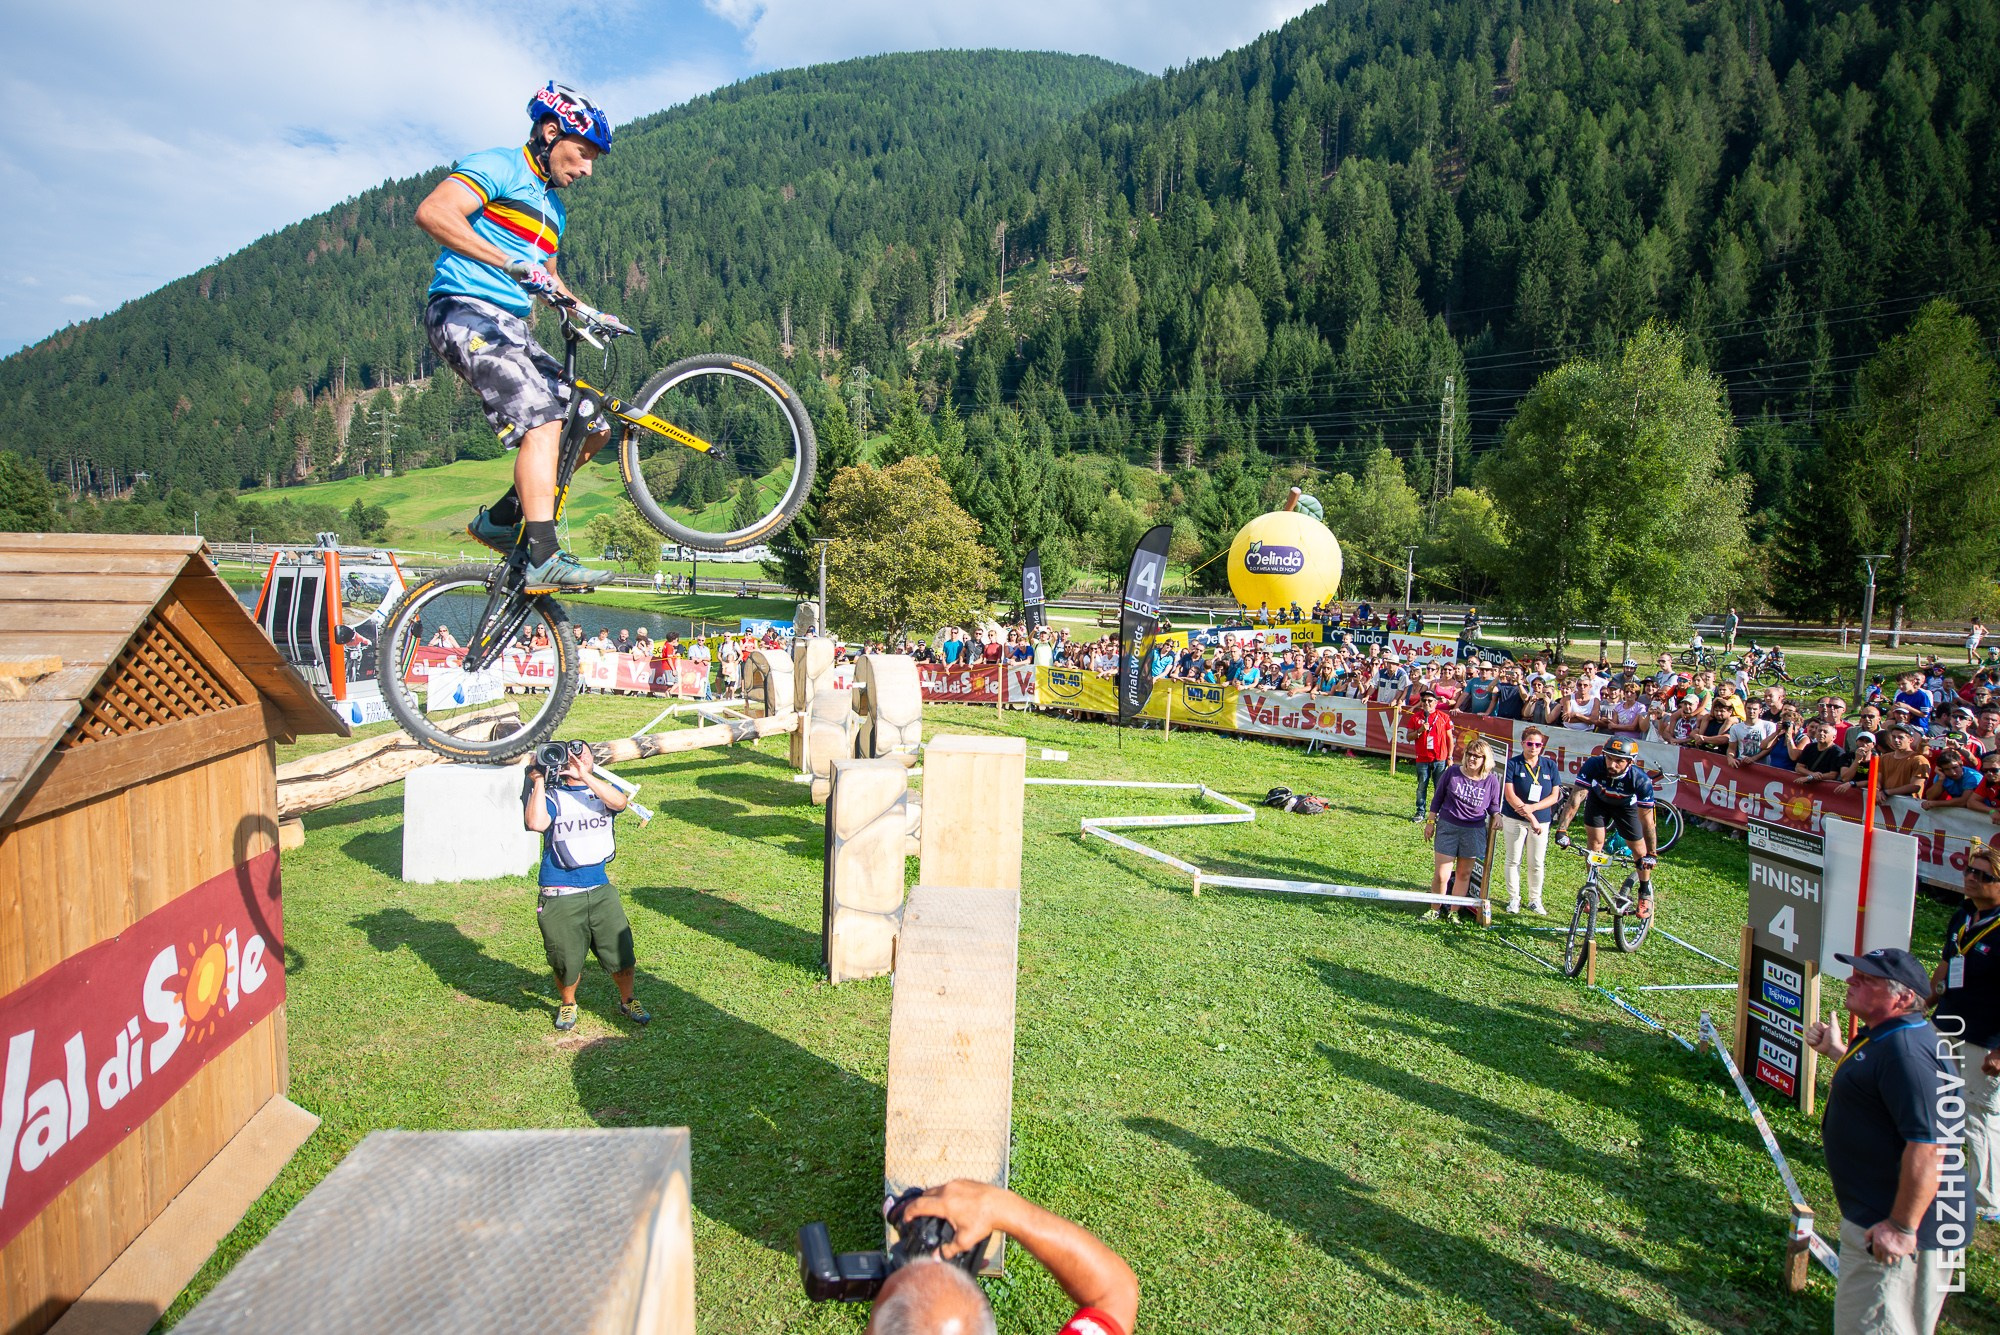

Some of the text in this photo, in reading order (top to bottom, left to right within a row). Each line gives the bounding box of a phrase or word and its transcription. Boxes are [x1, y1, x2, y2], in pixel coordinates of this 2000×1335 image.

[1246, 550, 1302, 567] Melinda
[1026, 572, 1039, 594] 3
[1136, 561, 1157, 597] 4
[1132, 602, 1150, 615] UCI
[1331, 629, 1383, 644] Mlinda
[1423, 640, 1454, 658] Sole
[512, 654, 544, 679] Val
[627, 660, 656, 684] Val
[1128, 625, 1145, 707] #TrialsWorlds
[921, 669, 999, 695] Val di Sole
[1015, 670, 1035, 696] Va
[1051, 671, 1081, 688] WD-40
[1187, 686, 1221, 704] WD-40
[365, 711, 390, 723] TONAL
[1243, 694, 1357, 737] Val di Sole
[1454, 782, 1486, 800] NIKE
[1693, 761, 1738, 810] Val
[1738, 792, 1761, 817] di
[554, 820, 574, 834] TV
[1751, 825, 1768, 838] UCI
[1751, 862, 1819, 904] FINISH
[1768, 904, 1799, 953] 4
[1773, 967, 1797, 989] UCI
[96, 1014, 144, 1111] di
[142, 926, 268, 1076] Sole
[1769, 1011, 1792, 1033] UCI
[1760, 1024, 1799, 1049] #TrialsWorlds
[1768, 1046, 1793, 1069] UCI
[1761, 1066, 1771, 1079] Val
